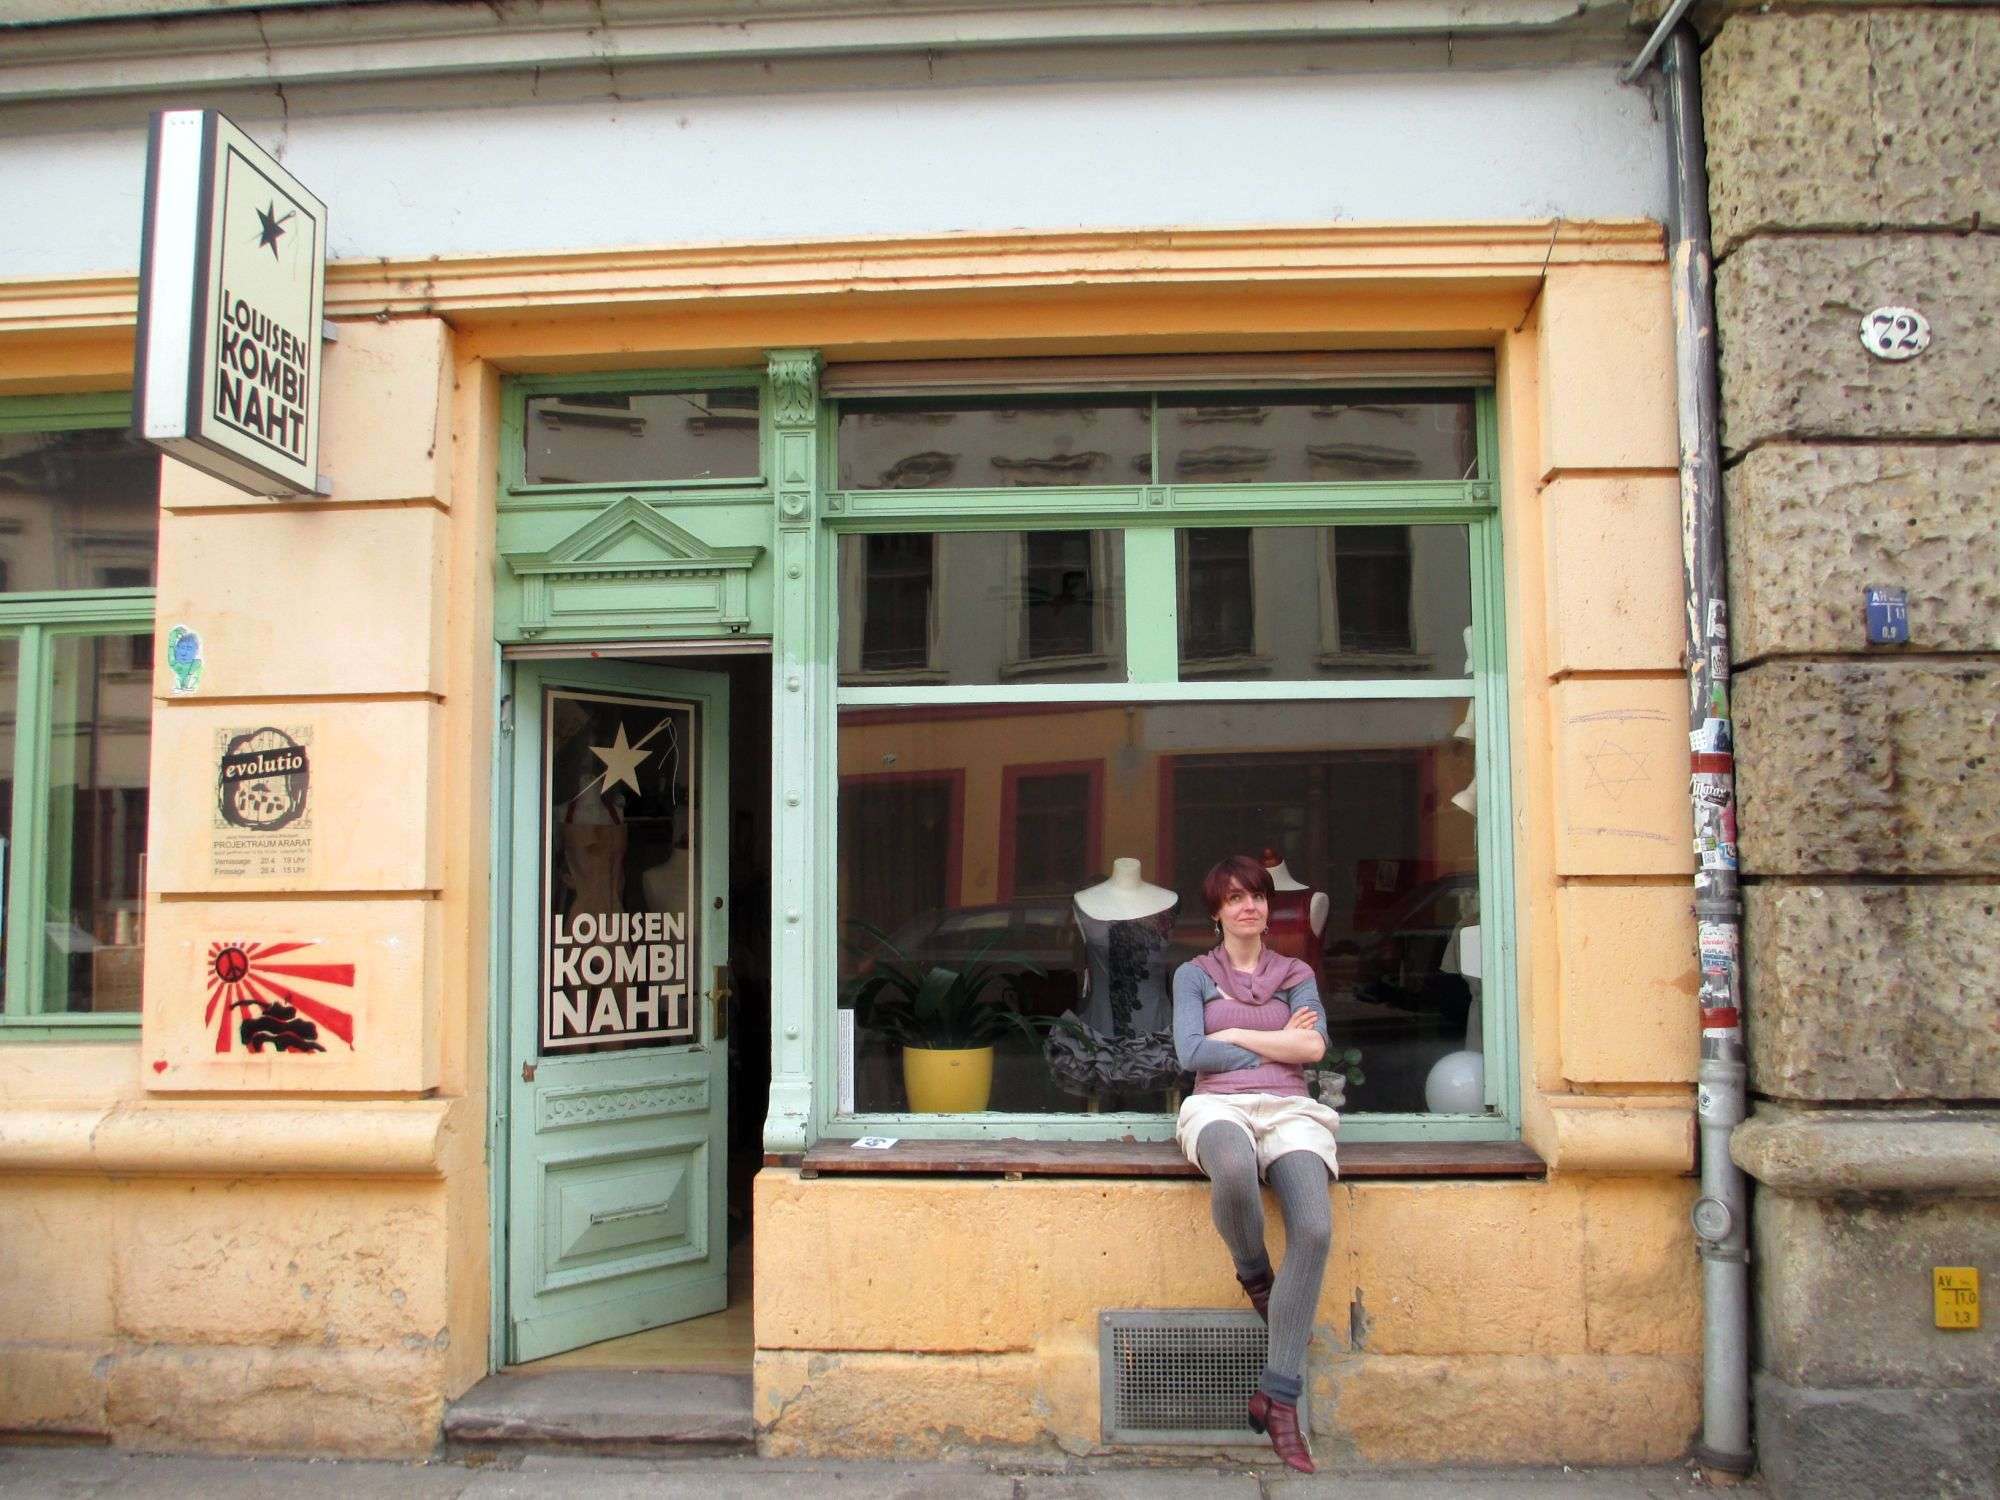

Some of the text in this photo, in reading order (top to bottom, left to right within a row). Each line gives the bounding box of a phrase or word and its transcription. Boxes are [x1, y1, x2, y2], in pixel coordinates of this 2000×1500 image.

[224, 288, 305, 370] LOUISEN
[220, 323, 305, 410] KOMBI
[218, 368, 304, 454] NAHT
[226, 752, 302, 777] evolutio
[213, 838, 312, 849] PROJEKTRAUM ARARAT
[555, 911, 685, 945] LOUISEN
[553, 943, 685, 987] KOMBI
[552, 984, 686, 1035] NAHT
